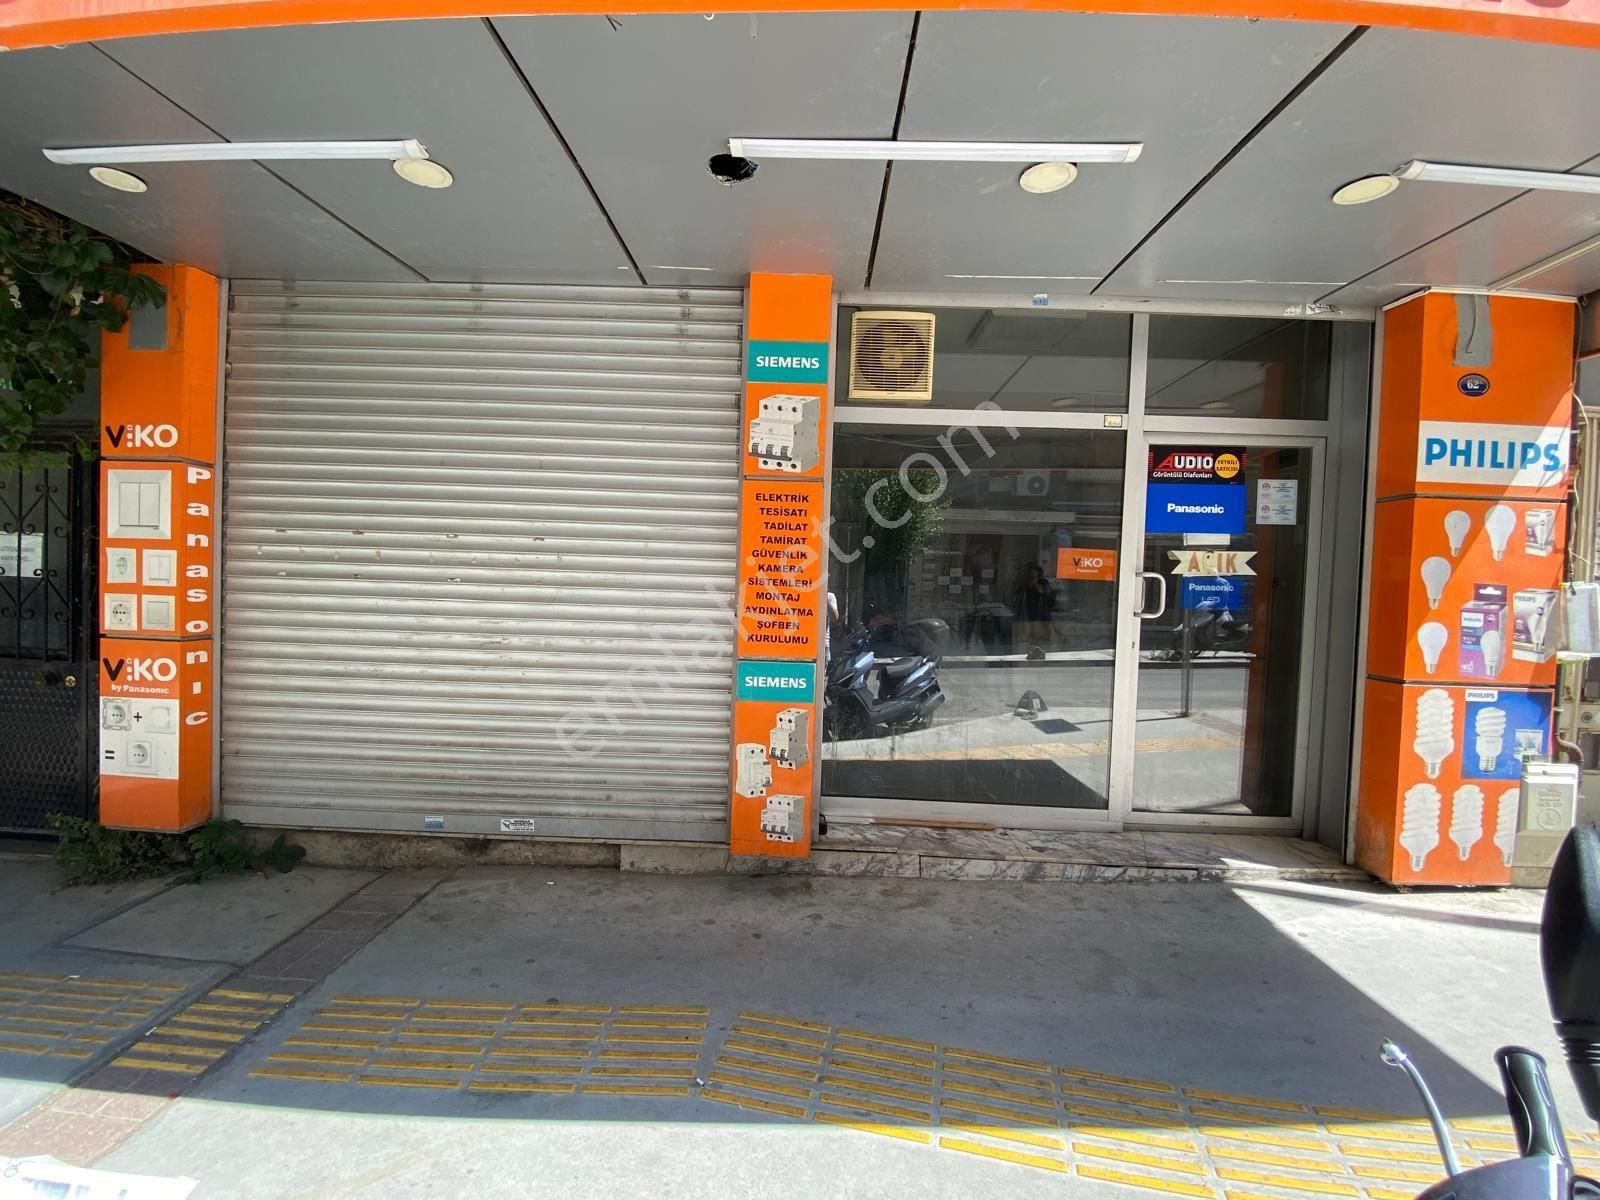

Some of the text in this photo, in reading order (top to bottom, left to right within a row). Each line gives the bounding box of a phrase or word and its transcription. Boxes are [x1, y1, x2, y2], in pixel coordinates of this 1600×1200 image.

[756, 355, 820, 369] SIEMENS
[1467, 379, 1480, 389] 62
[1424, 437, 1561, 472] PHILIPS
[1157, 453, 1213, 470] AUDIO
[755, 493, 809, 503] ELEKTRİK
[759, 507, 808, 517] TESİSATI
[1167, 503, 1225, 514] Panasonic
[764, 521, 808, 532] TADİLAT
[760, 535, 808, 545] TAMİRAT
[758, 563, 804, 574] KAMERA
[747, 576, 812, 588] SİSTEMLERİ
[1188, 583, 1234, 592] Panasonic
[185, 466, 212, 726] Panasonic
[755, 591, 800, 602] MONTAJ
[744, 605, 814, 617] AYDINLATMA
[747, 634, 809, 645] KURULUMU
[745, 676, 807, 689] SIEMENS
[111, 683, 170, 695] by Panasonic
[1467, 692, 1496, 700] PHILIPS
